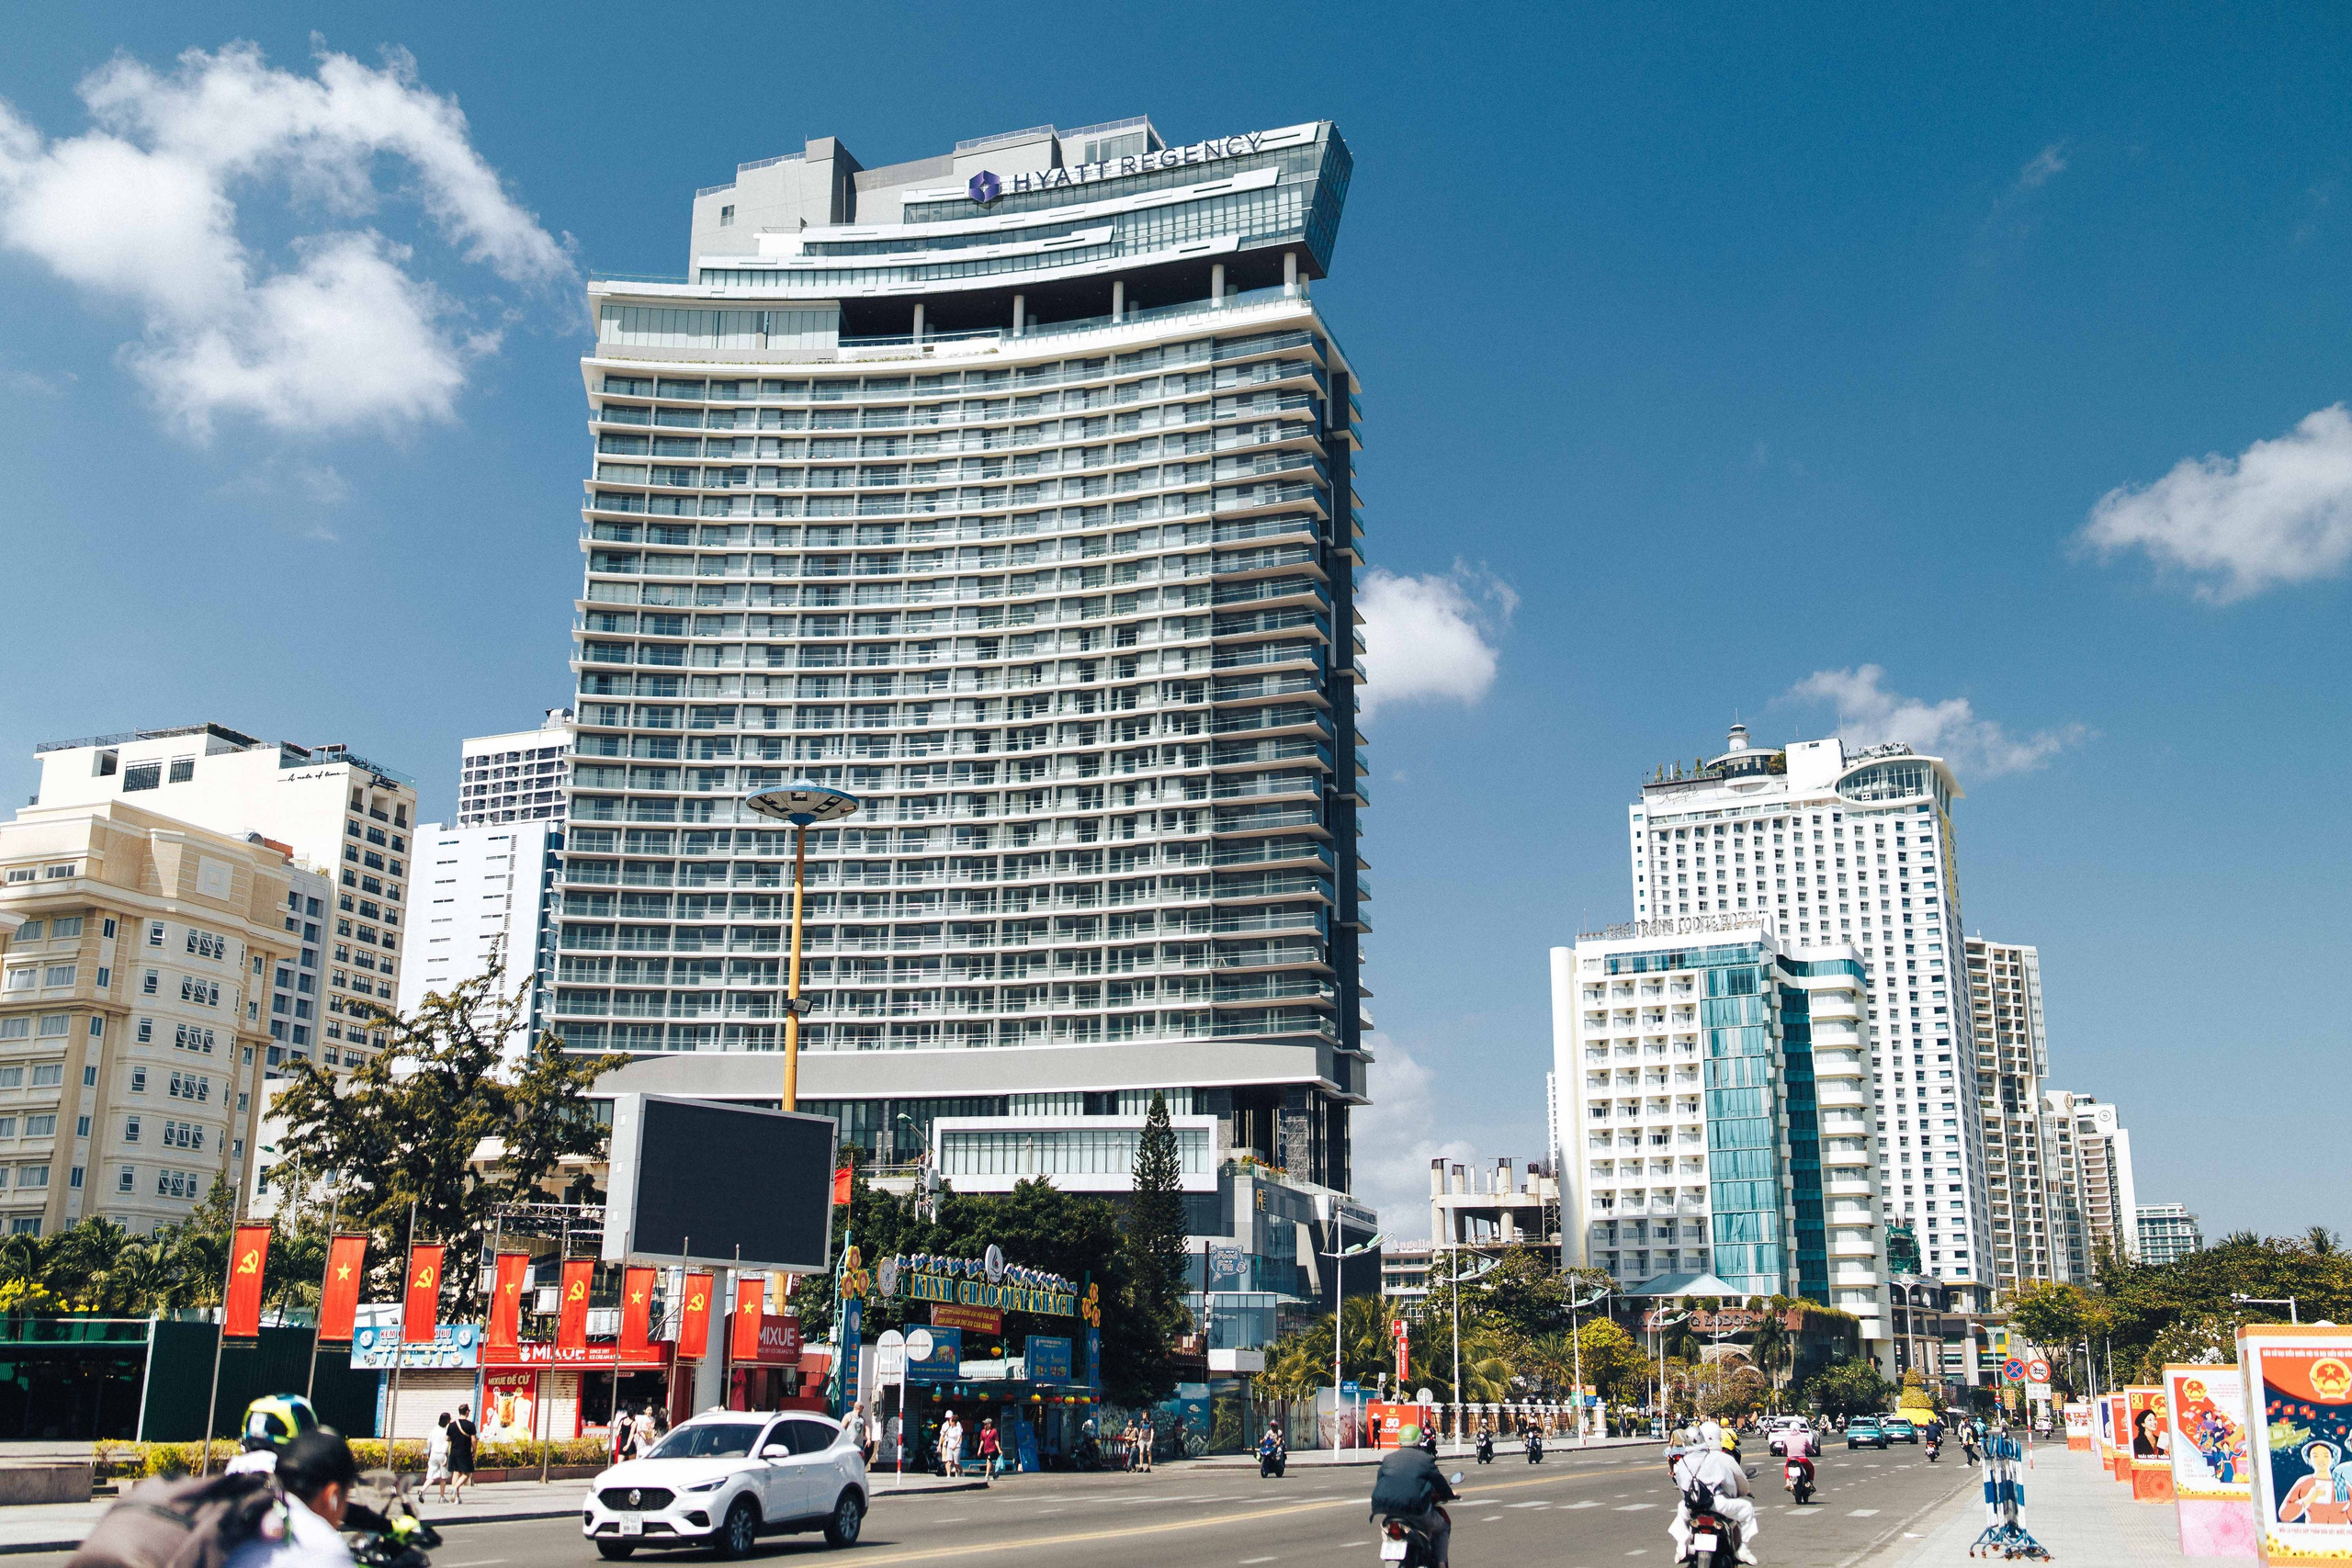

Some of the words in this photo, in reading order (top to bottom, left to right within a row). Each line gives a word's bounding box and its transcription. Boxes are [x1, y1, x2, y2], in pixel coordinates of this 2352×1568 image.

[1014, 158, 1108, 192] HYATT
[1121, 131, 1264, 175] REGENCY
[759, 1325, 795, 1347] MIXUE
[2131, 1393, 2143, 1404] 80
